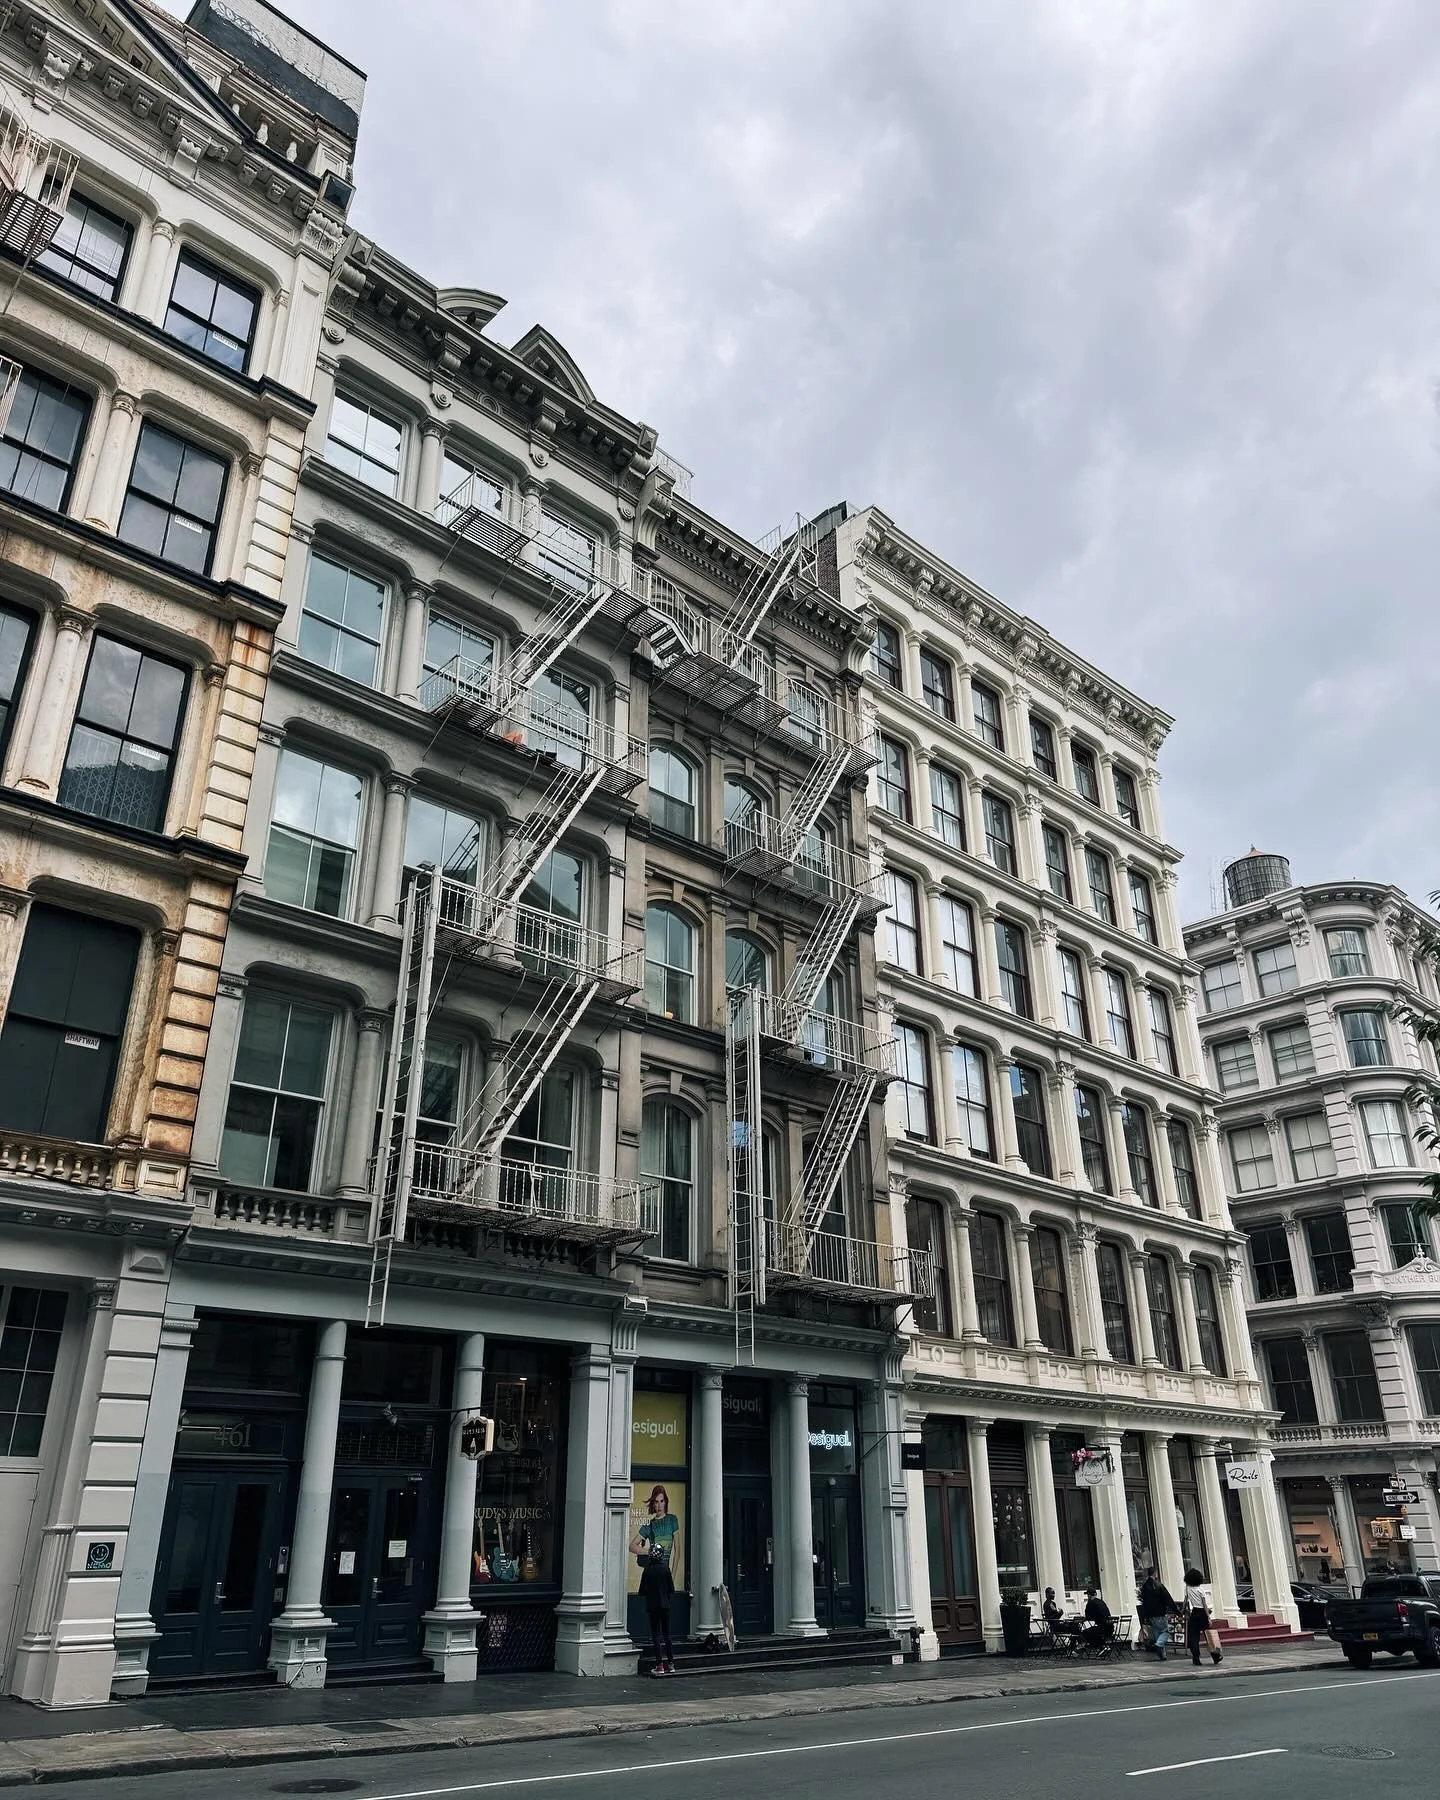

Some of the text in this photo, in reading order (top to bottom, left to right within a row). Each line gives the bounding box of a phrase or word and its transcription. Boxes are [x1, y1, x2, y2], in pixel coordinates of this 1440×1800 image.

[66, 1032, 99, 1047] SHAFTWAY
[215, 1422, 250, 1448] 461
[1228, 1467, 1258, 1483] Rails
[509, 1507, 543, 1519] MUSIC
